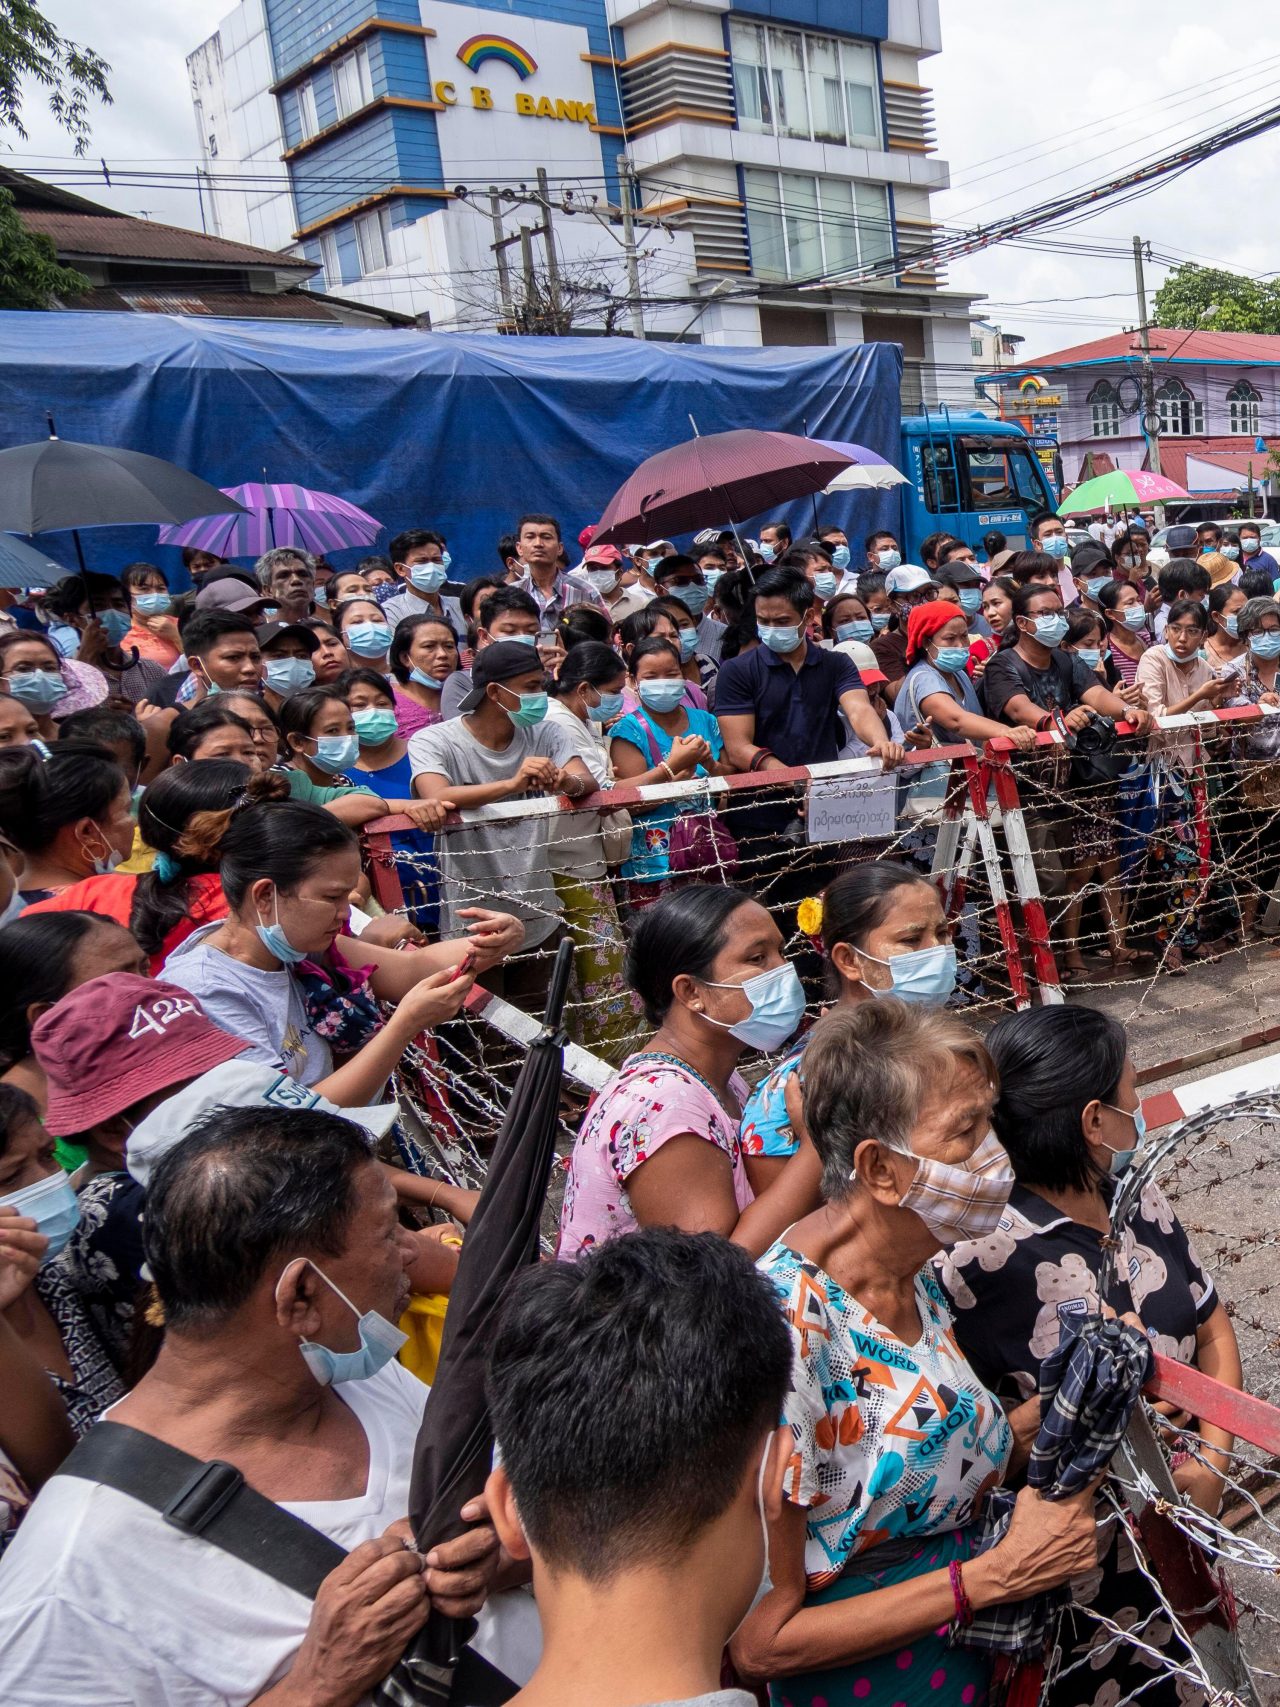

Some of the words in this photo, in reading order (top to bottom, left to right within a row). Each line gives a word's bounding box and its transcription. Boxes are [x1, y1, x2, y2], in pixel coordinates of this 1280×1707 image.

[515, 93, 597, 124] BANK
[128, 997, 203, 1040] 424
[855, 1333, 917, 1372] WORD
[919, 1396, 974, 1456] WORD
